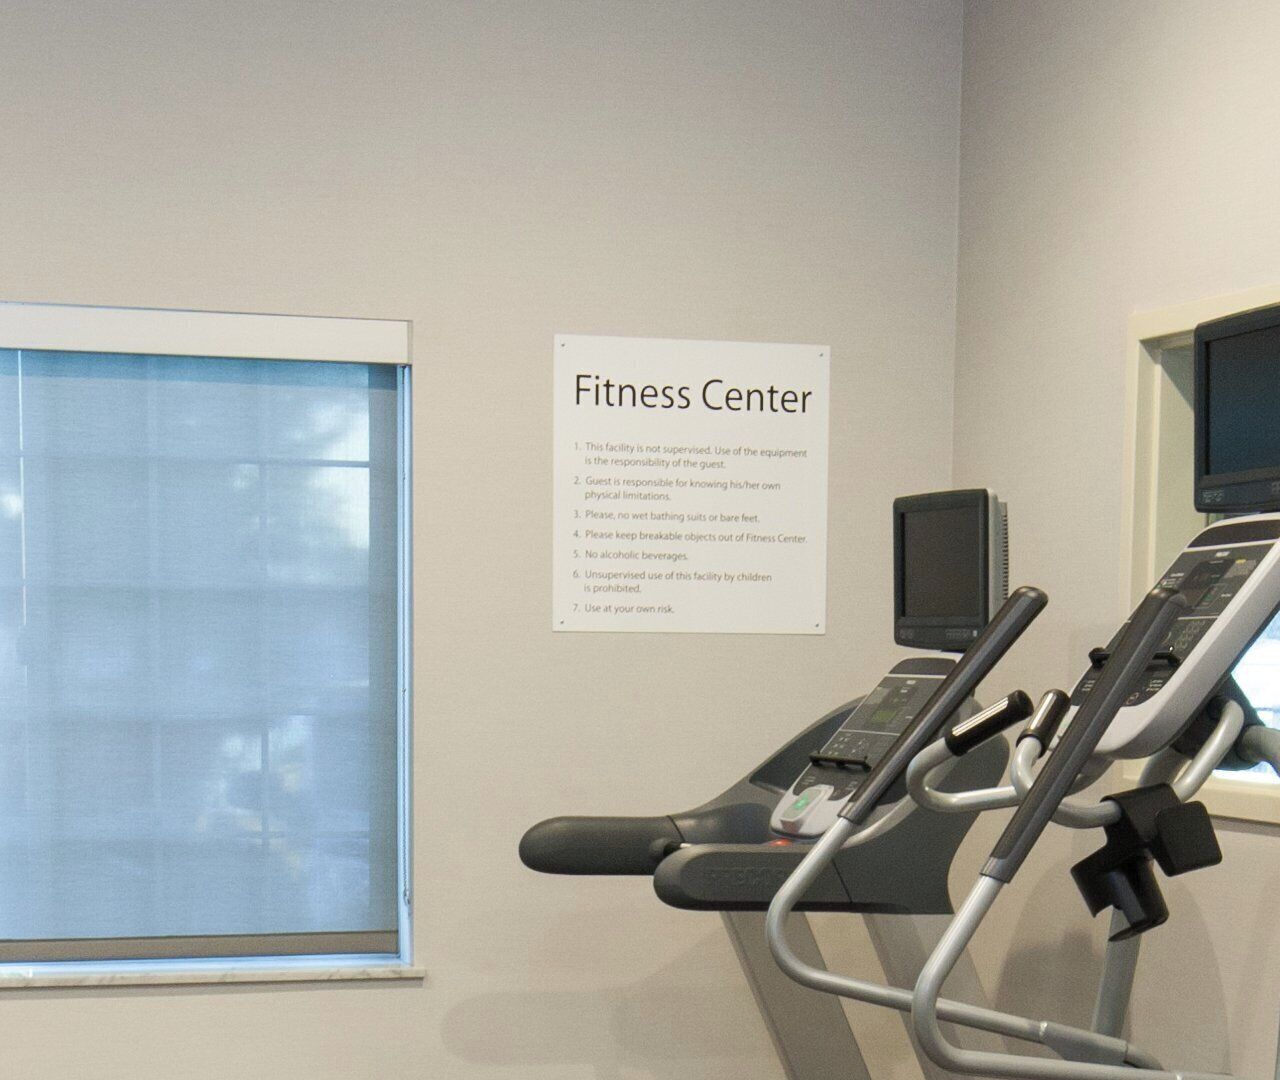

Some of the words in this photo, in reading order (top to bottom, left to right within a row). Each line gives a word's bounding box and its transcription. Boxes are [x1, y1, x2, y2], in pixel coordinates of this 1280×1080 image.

[575, 373, 691, 410] Fitness
[701, 378, 813, 414] Center
[585, 441, 603, 452] This
[605, 441, 635, 454] facility
[636, 444, 644, 453] is
[645, 445, 661, 453] not
[714, 446, 731, 455] Use
[732, 446, 742, 456] of
[743, 447, 758, 456] the
[759, 448, 807, 459] equipment
[584, 457, 592, 465] is
[593, 455, 609, 465] the
[610, 457, 670, 469] responsibility
[671, 458, 681, 467] of
[682, 458, 698, 468] the
[585, 475, 612, 486] Guest
[613, 477, 621, 486] is
[622, 477, 674, 488] responsible
[675, 478, 688, 487] for
[689, 478, 728, 491] knowing
[729, 479, 760, 490] his/her
[761, 482, 780, 490] own
[584, 489, 621, 501] physical
[631, 512, 648, 520] wet
[650, 511, 685, 523] bathing
[686, 513, 707, 521] suits
[719, 513, 739, 522] bare
[585, 529, 613, 539] Please
[615, 530, 637, 541] keep
[639, 530, 683, 541] breakable
[684, 531, 716, 543] objects
[717, 533, 733, 542] out
[734, 532, 744, 542] of
[745, 532, 776, 542] Fitness
[585, 549, 598, 559] No
[599, 550, 639, 560] alcoholic
[584, 569, 645, 581] Unsupervised
[647, 572, 663, 580] use
[664, 570, 674, 580] of
[675, 571, 692, 580] this
[693, 571, 722, 583] facility
[723, 572, 735, 583] by
[736, 572, 772, 582] children
[583, 583, 591, 592] is
[584, 603, 601, 613] Use
[602, 604, 612, 613] at
[613, 605, 634, 614] your
[635, 605, 655, 613] own
